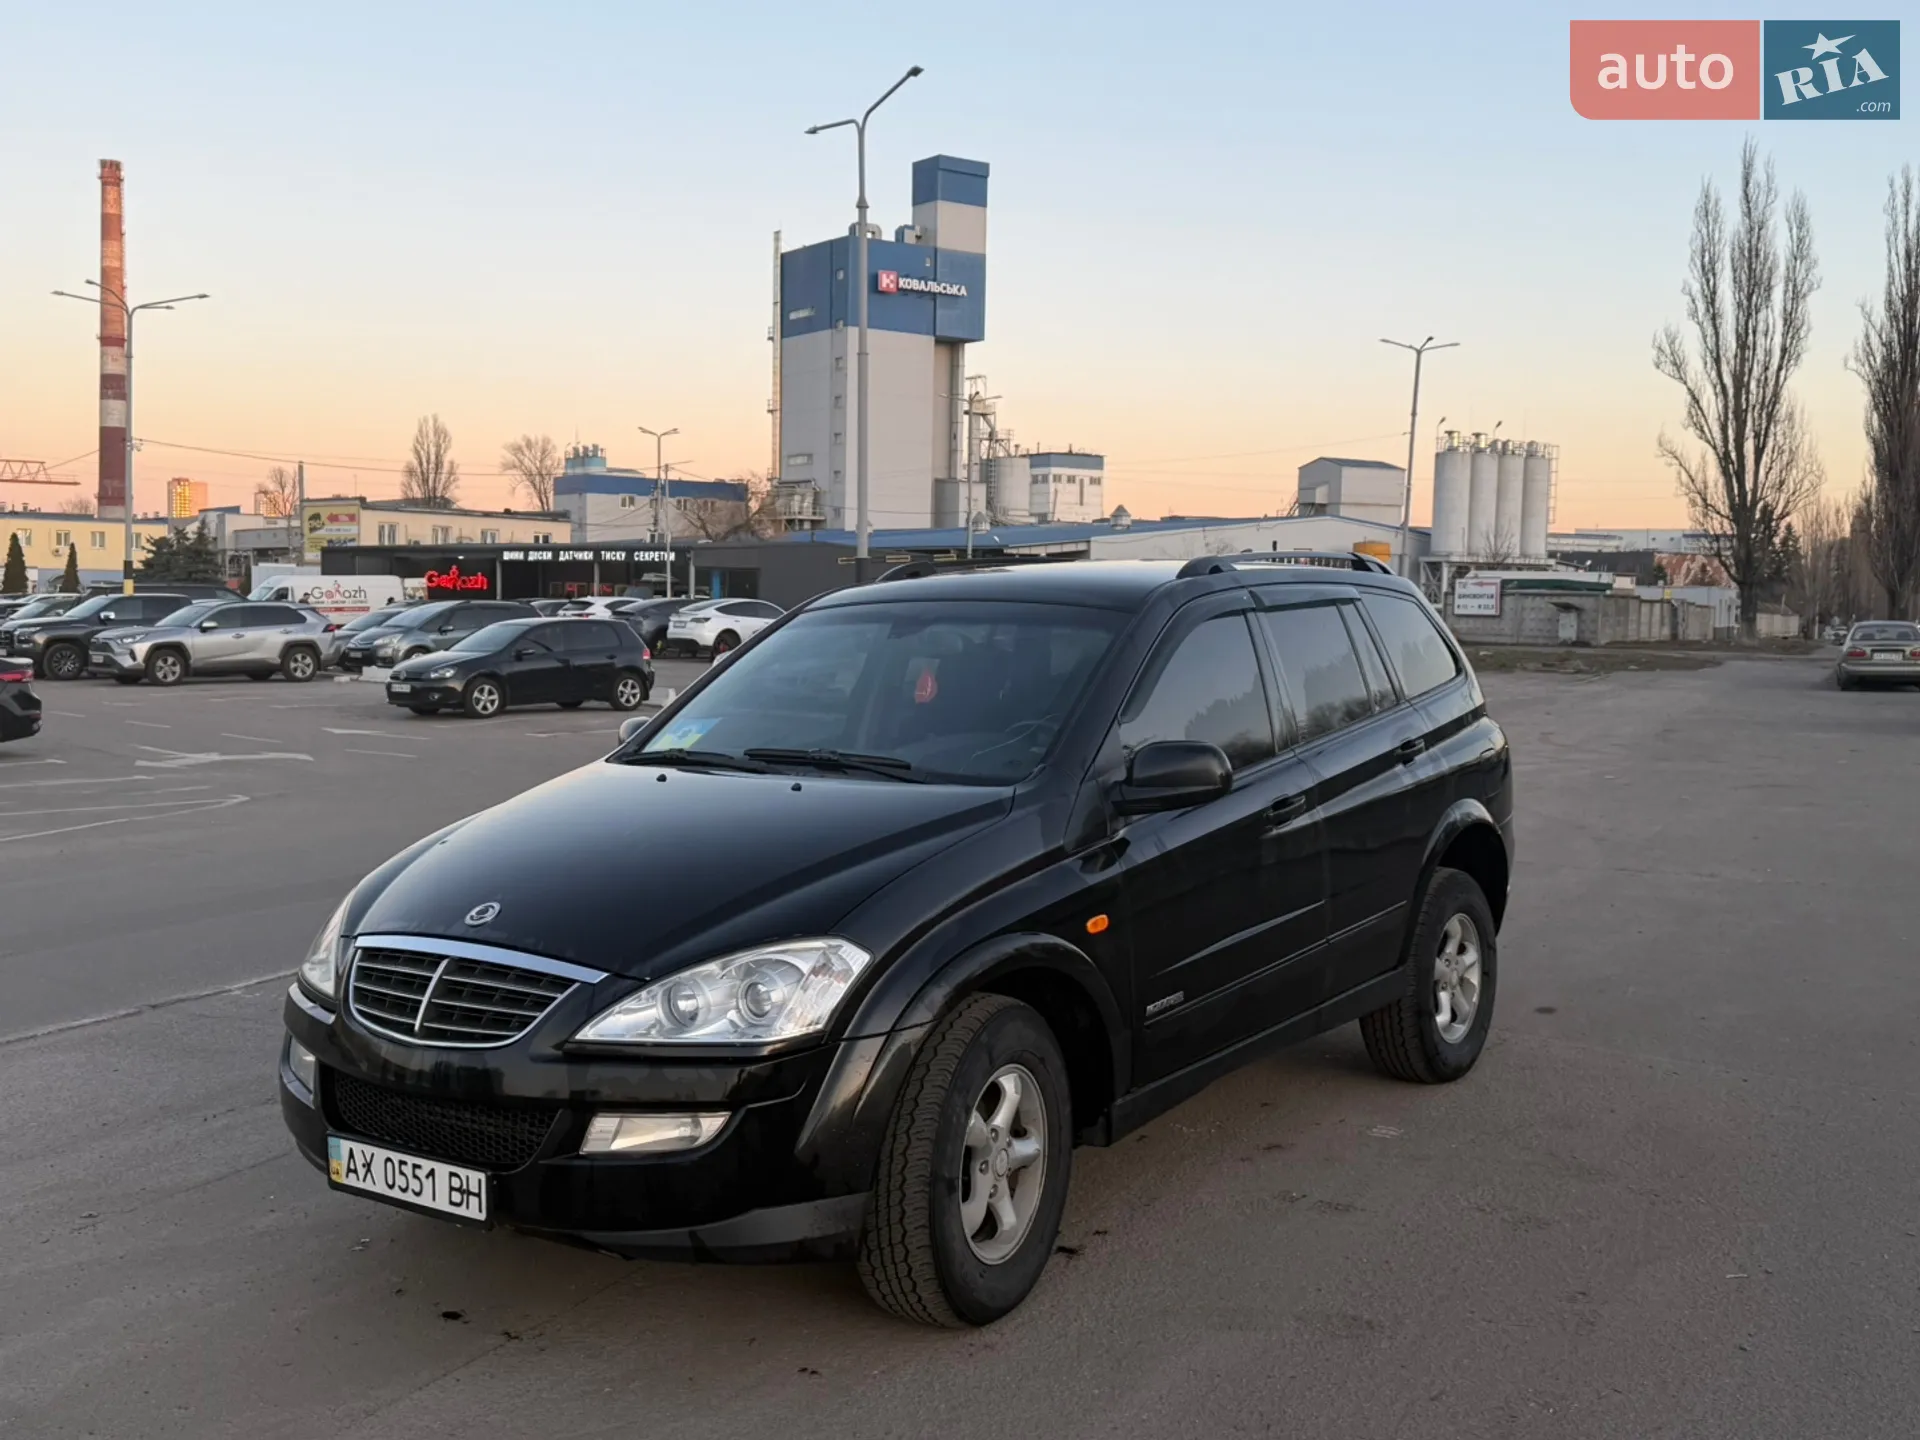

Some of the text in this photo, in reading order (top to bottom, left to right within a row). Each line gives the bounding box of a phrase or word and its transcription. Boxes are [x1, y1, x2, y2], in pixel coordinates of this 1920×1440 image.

[898, 277, 967, 296] КОВАЛЬСЬКА
[503, 550, 524, 560] ШИНИ
[528, 550, 553, 561] ДИСКИ
[558, 550, 594, 561] ДАТЧИКИ
[600, 550, 626, 561] ТИСКУ
[384, 1157, 437, 1202] 0551
